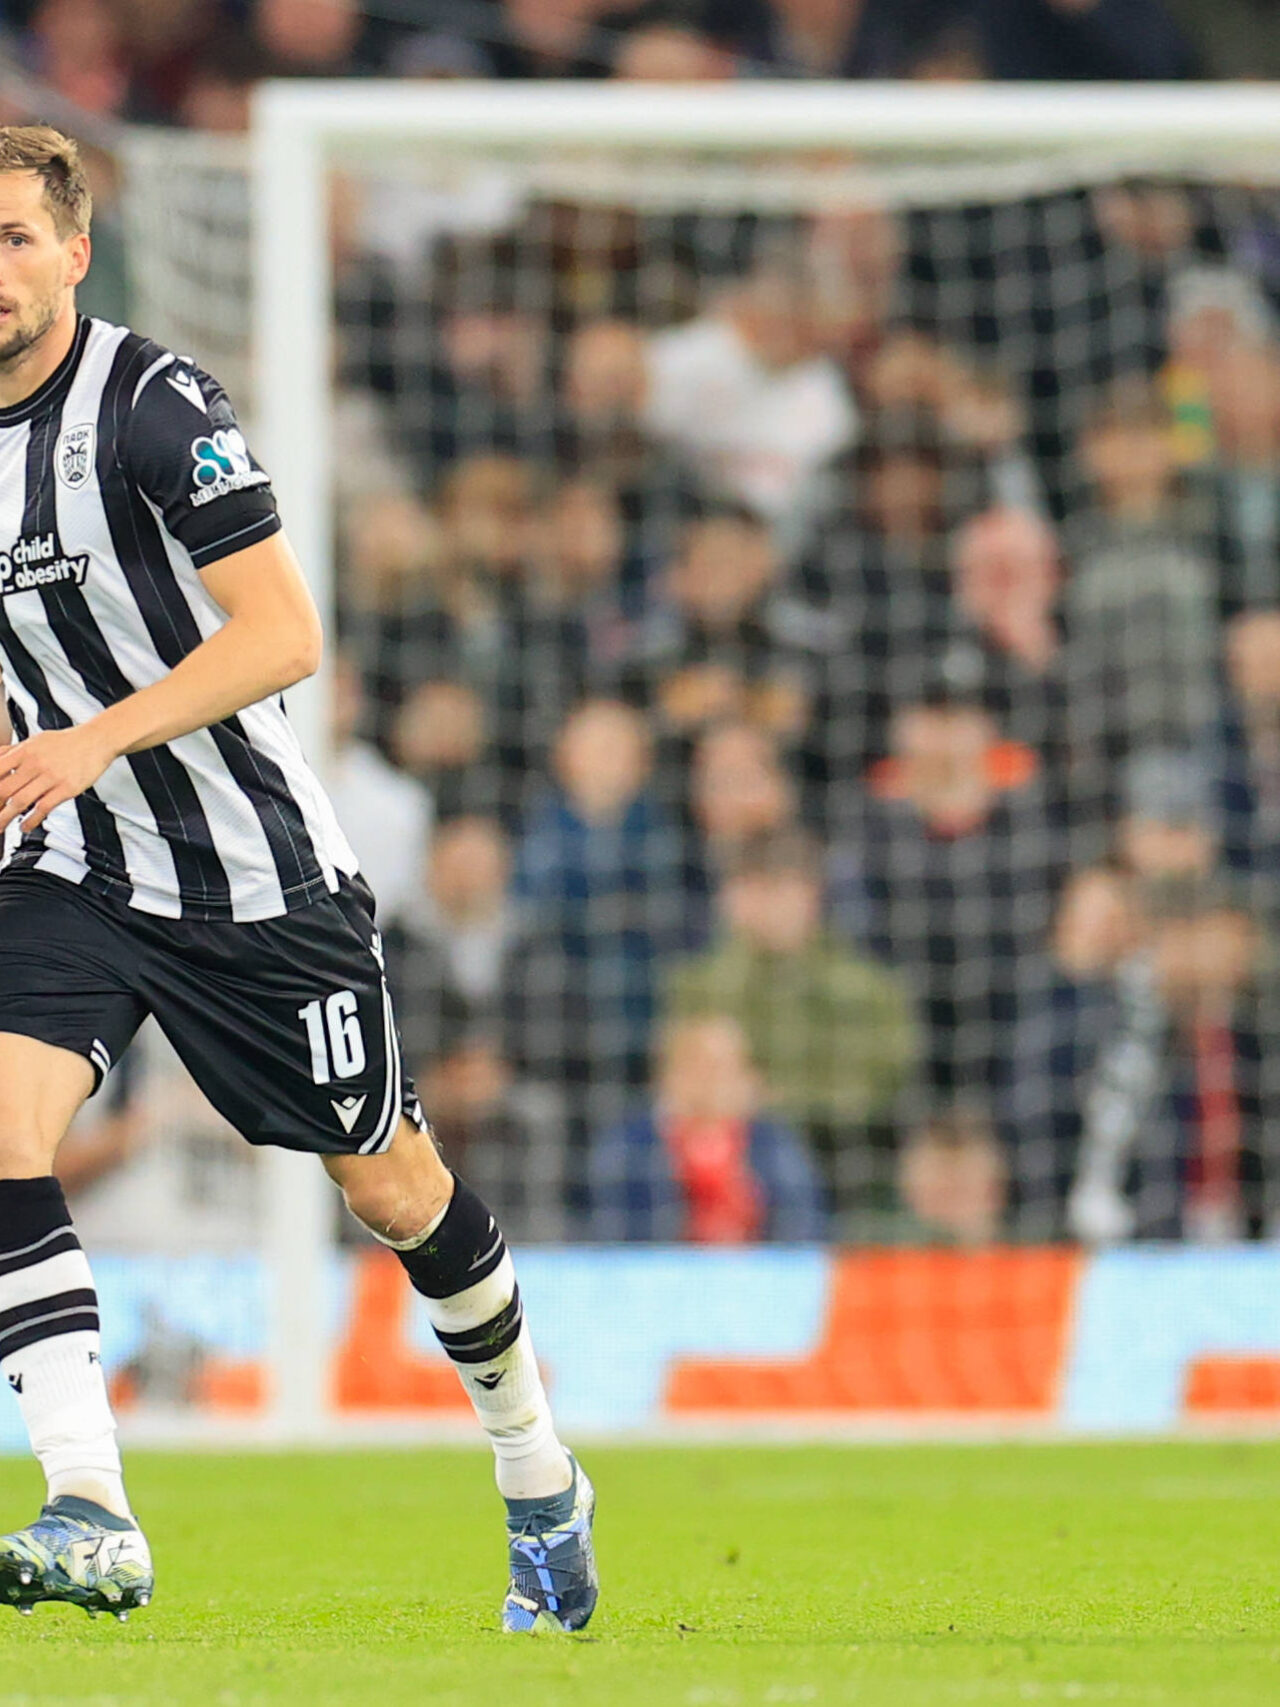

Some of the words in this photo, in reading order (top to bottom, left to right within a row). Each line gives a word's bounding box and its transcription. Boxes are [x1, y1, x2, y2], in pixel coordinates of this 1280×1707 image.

[14, 533, 55, 563] child
[15, 558, 87, 588] obesity
[298, 989, 366, 1085] 16
